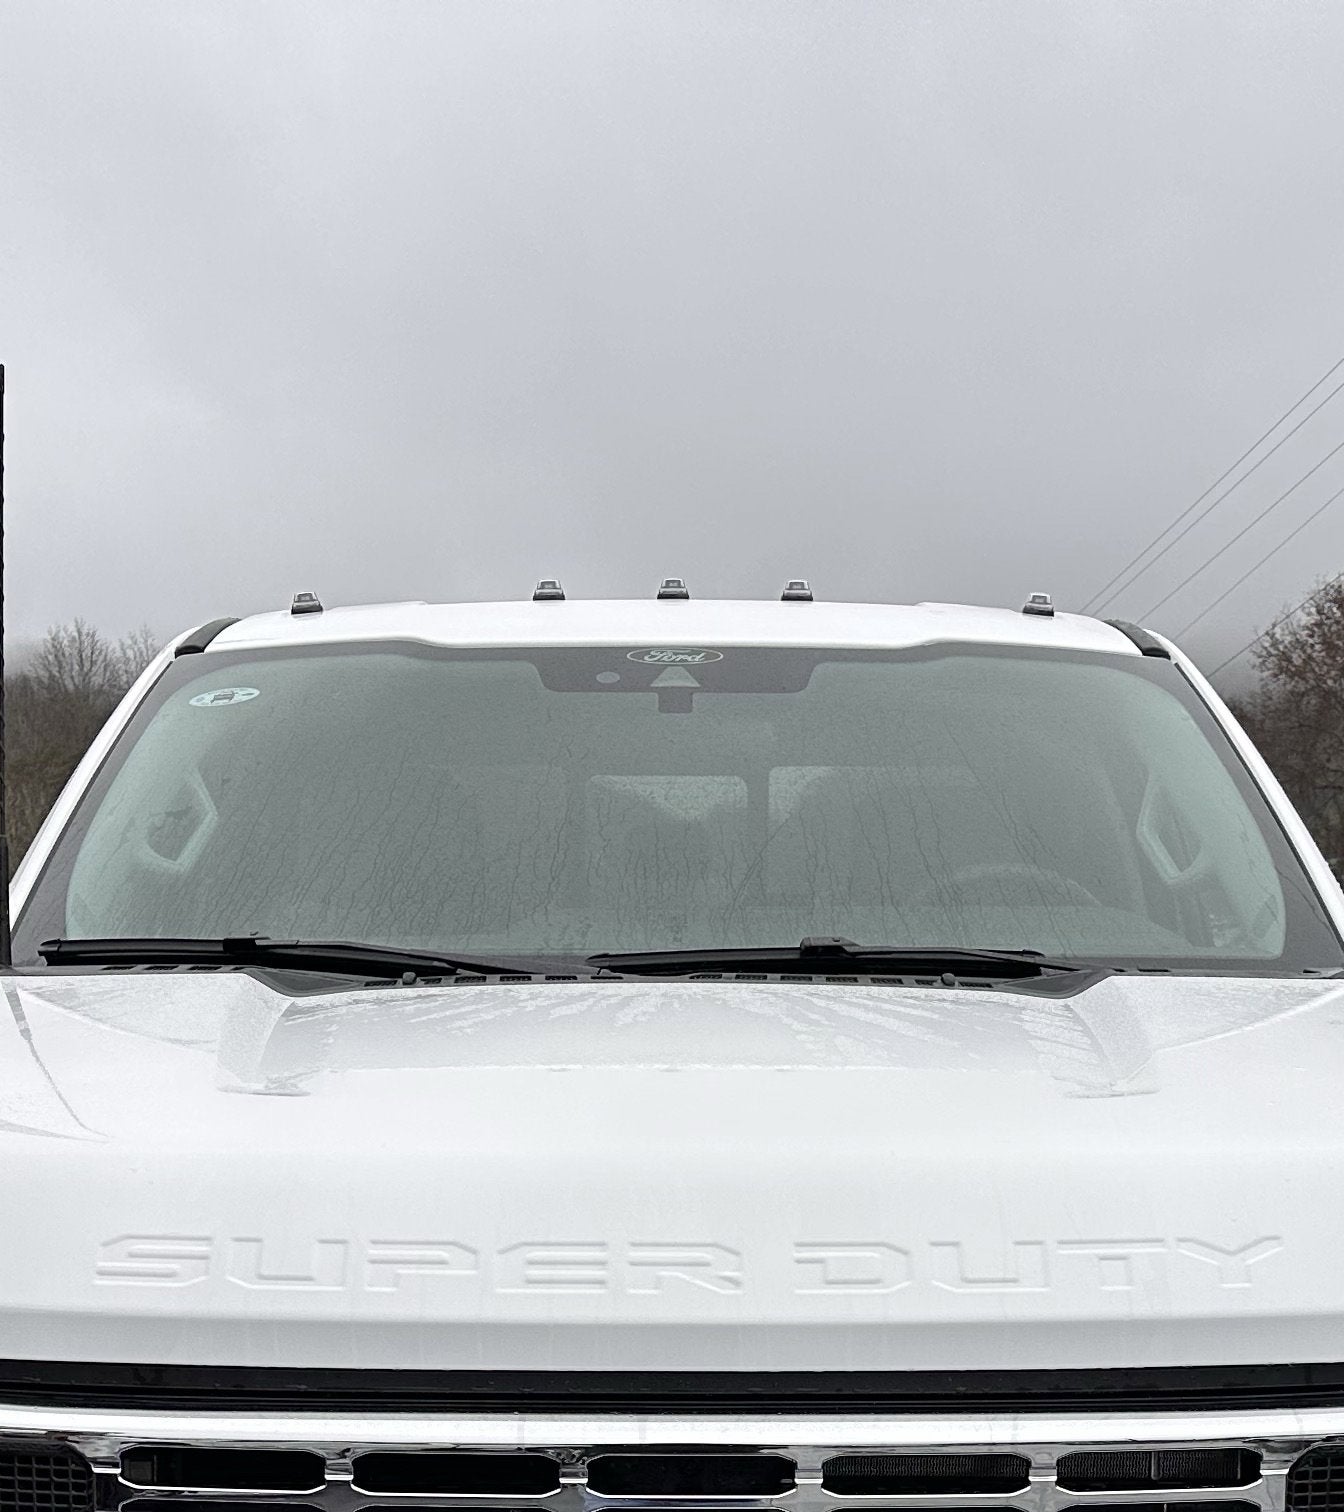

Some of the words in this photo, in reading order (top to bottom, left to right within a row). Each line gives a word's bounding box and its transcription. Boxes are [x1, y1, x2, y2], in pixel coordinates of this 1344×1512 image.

[644, 650, 706, 663] Ford
[93, 1234, 744, 1294] SUPER
[792, 1235, 1284, 1294] DUTY
